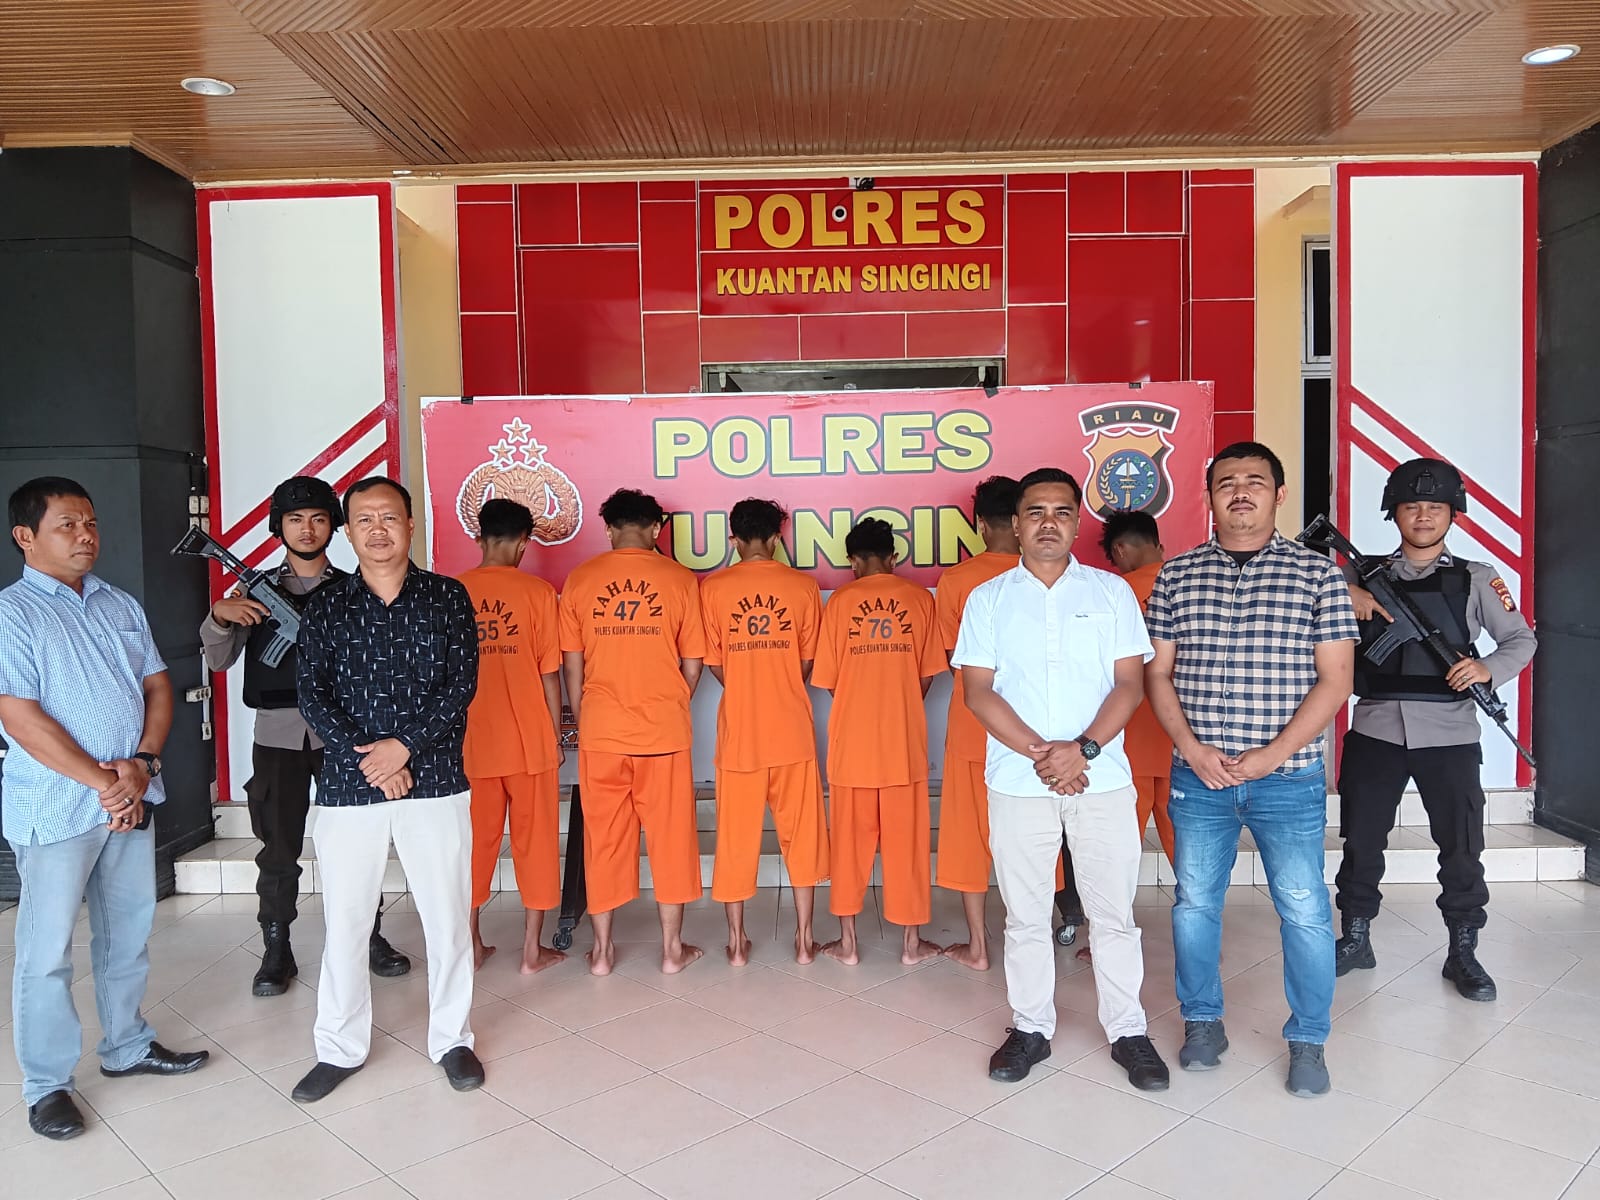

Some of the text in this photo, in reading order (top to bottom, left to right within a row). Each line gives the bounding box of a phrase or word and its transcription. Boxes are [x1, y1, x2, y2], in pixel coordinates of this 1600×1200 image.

[714, 189, 986, 249] POLRES
[716, 262, 991, 295] KUANTAN SINGINGI
[1093, 409, 1165, 425] RIAU
[653, 409, 993, 479] POLRES
[592, 578, 663, 620] TAHANAN
[613, 600, 641, 621] 47
[729, 593, 792, 636] TAHANAN
[474, 598, 519, 637] ANAN
[477, 619, 499, 642] 55
[747, 614, 771, 637] 62
[849, 597, 913, 640] TAHANAN
[867, 617, 893, 639] 76
